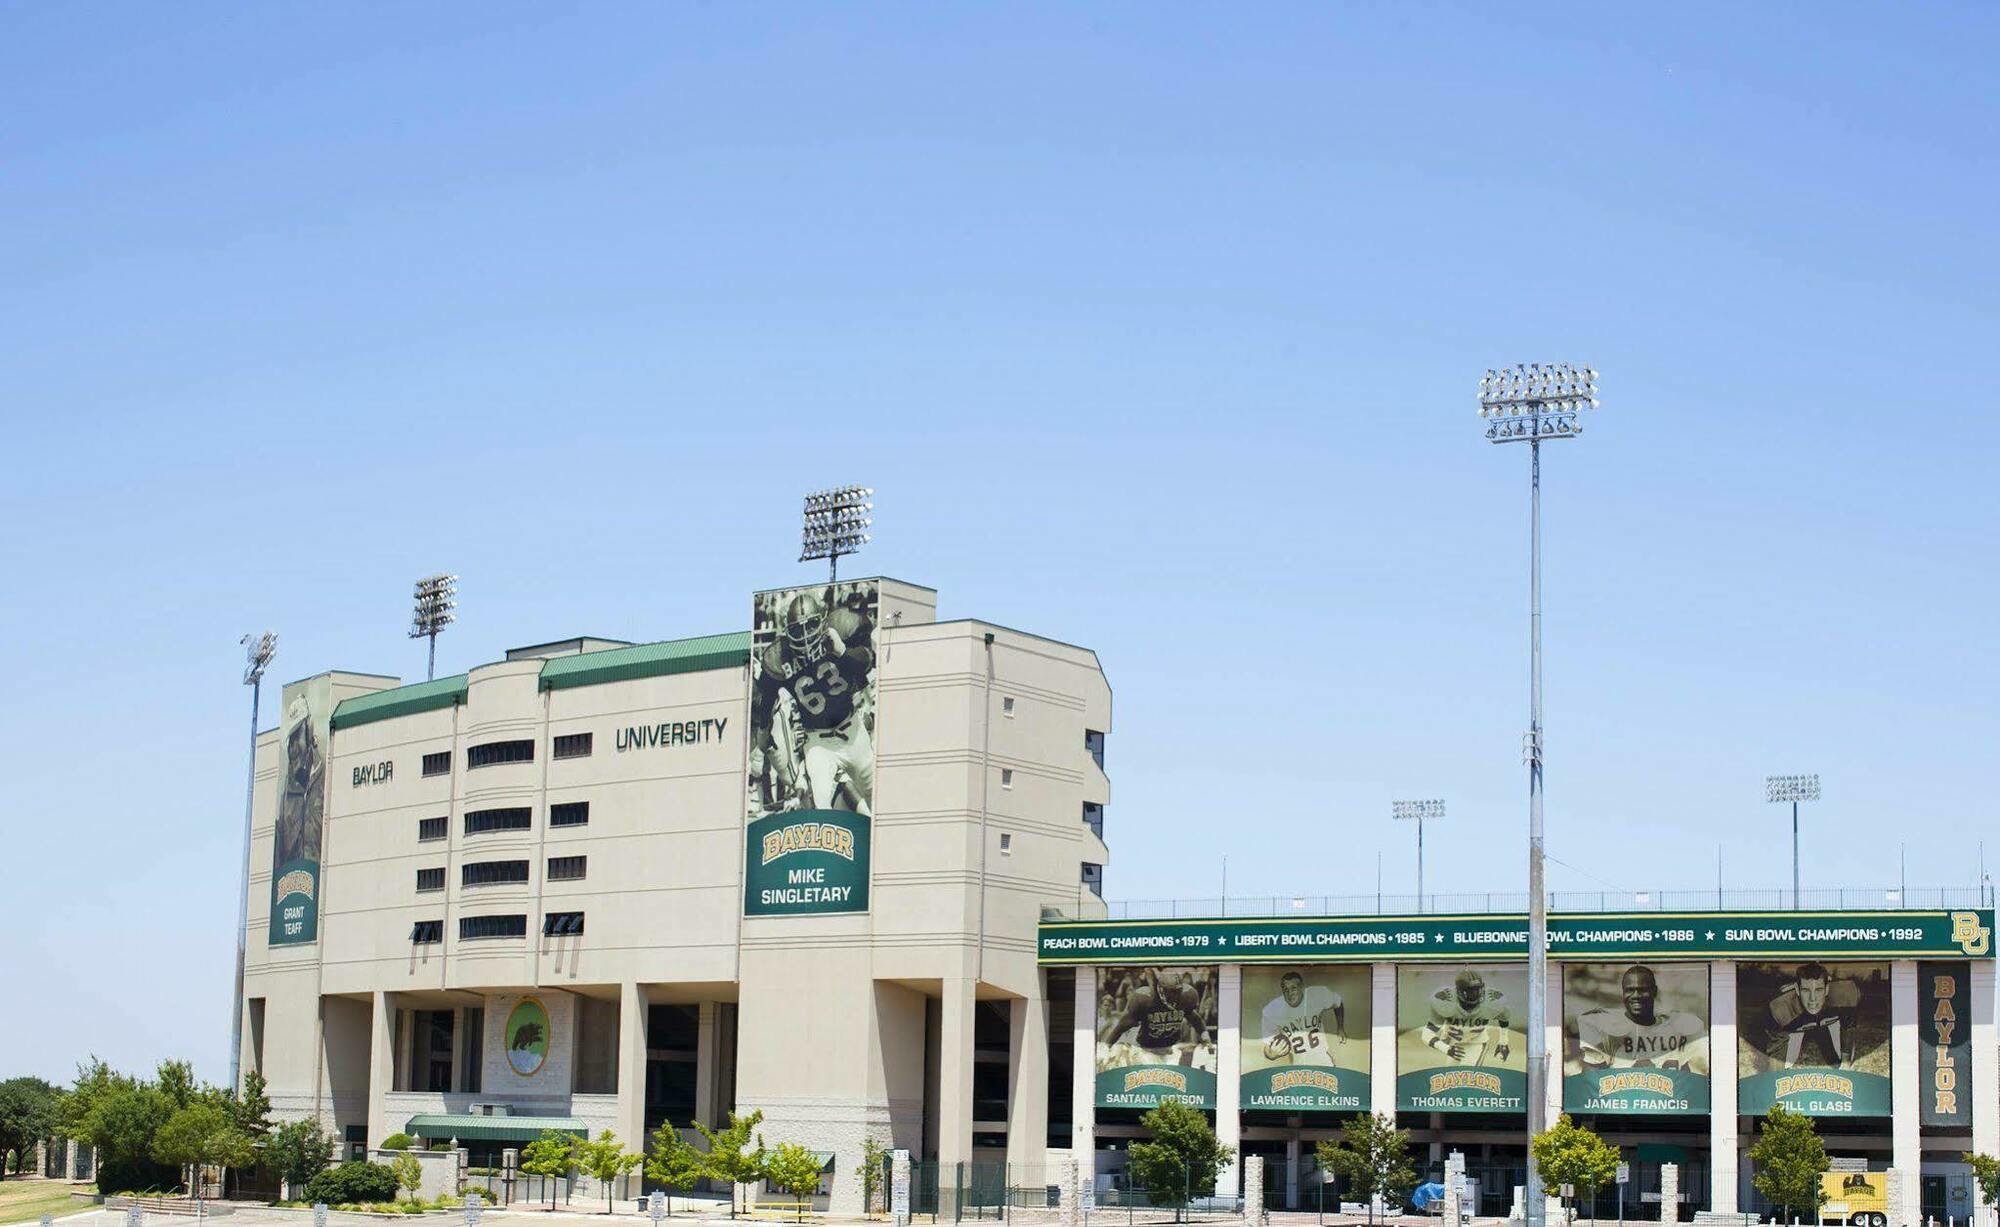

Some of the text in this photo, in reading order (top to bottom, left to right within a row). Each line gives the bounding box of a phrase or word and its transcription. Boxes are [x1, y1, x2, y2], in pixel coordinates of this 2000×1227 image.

[795, 661, 848, 715] 63
[353, 717, 728, 787] BAYLOR UNIVERSITY
[762, 823, 854, 865] BAYLOR
[788, 868, 825, 884] MIKE
[761, 886, 852, 904] SINGLETARY
[283, 906, 304, 920] GRANT
[284, 922, 303, 935] TEAFF
[1044, 928, 1923, 949] PEACH BOWL CHAMPIONS 1979 LIBERTY BOWL CHAMPIONS 1985 BLUEBONNE OWL CHAMPIONS 1986 SUN BOWL CHAMPIONS 1992
[1292, 1029, 1320, 1054] 26
[1623, 1035, 1688, 1054] BAYLOR
[1935, 975, 1957, 1114] BAYLOR
[1271, 1069, 1338, 1095] BAYLOR
[1429, 1070, 1502, 1096] BAYLOR
[1599, 1072, 1674, 1098] BAYLOR
[1775, 1073, 1854, 1100] BAYLOR
[1106, 1093, 1157, 1104] SANTANA
[1250, 1095, 1360, 1107] LAWRENCE ELKINS
[1411, 1096, 1520, 1108] THOMAS EVERETT
[1584, 1099, 1688, 1111] JAMES FRANCIS
[1809, 1101, 1852, 1112] GLASS
